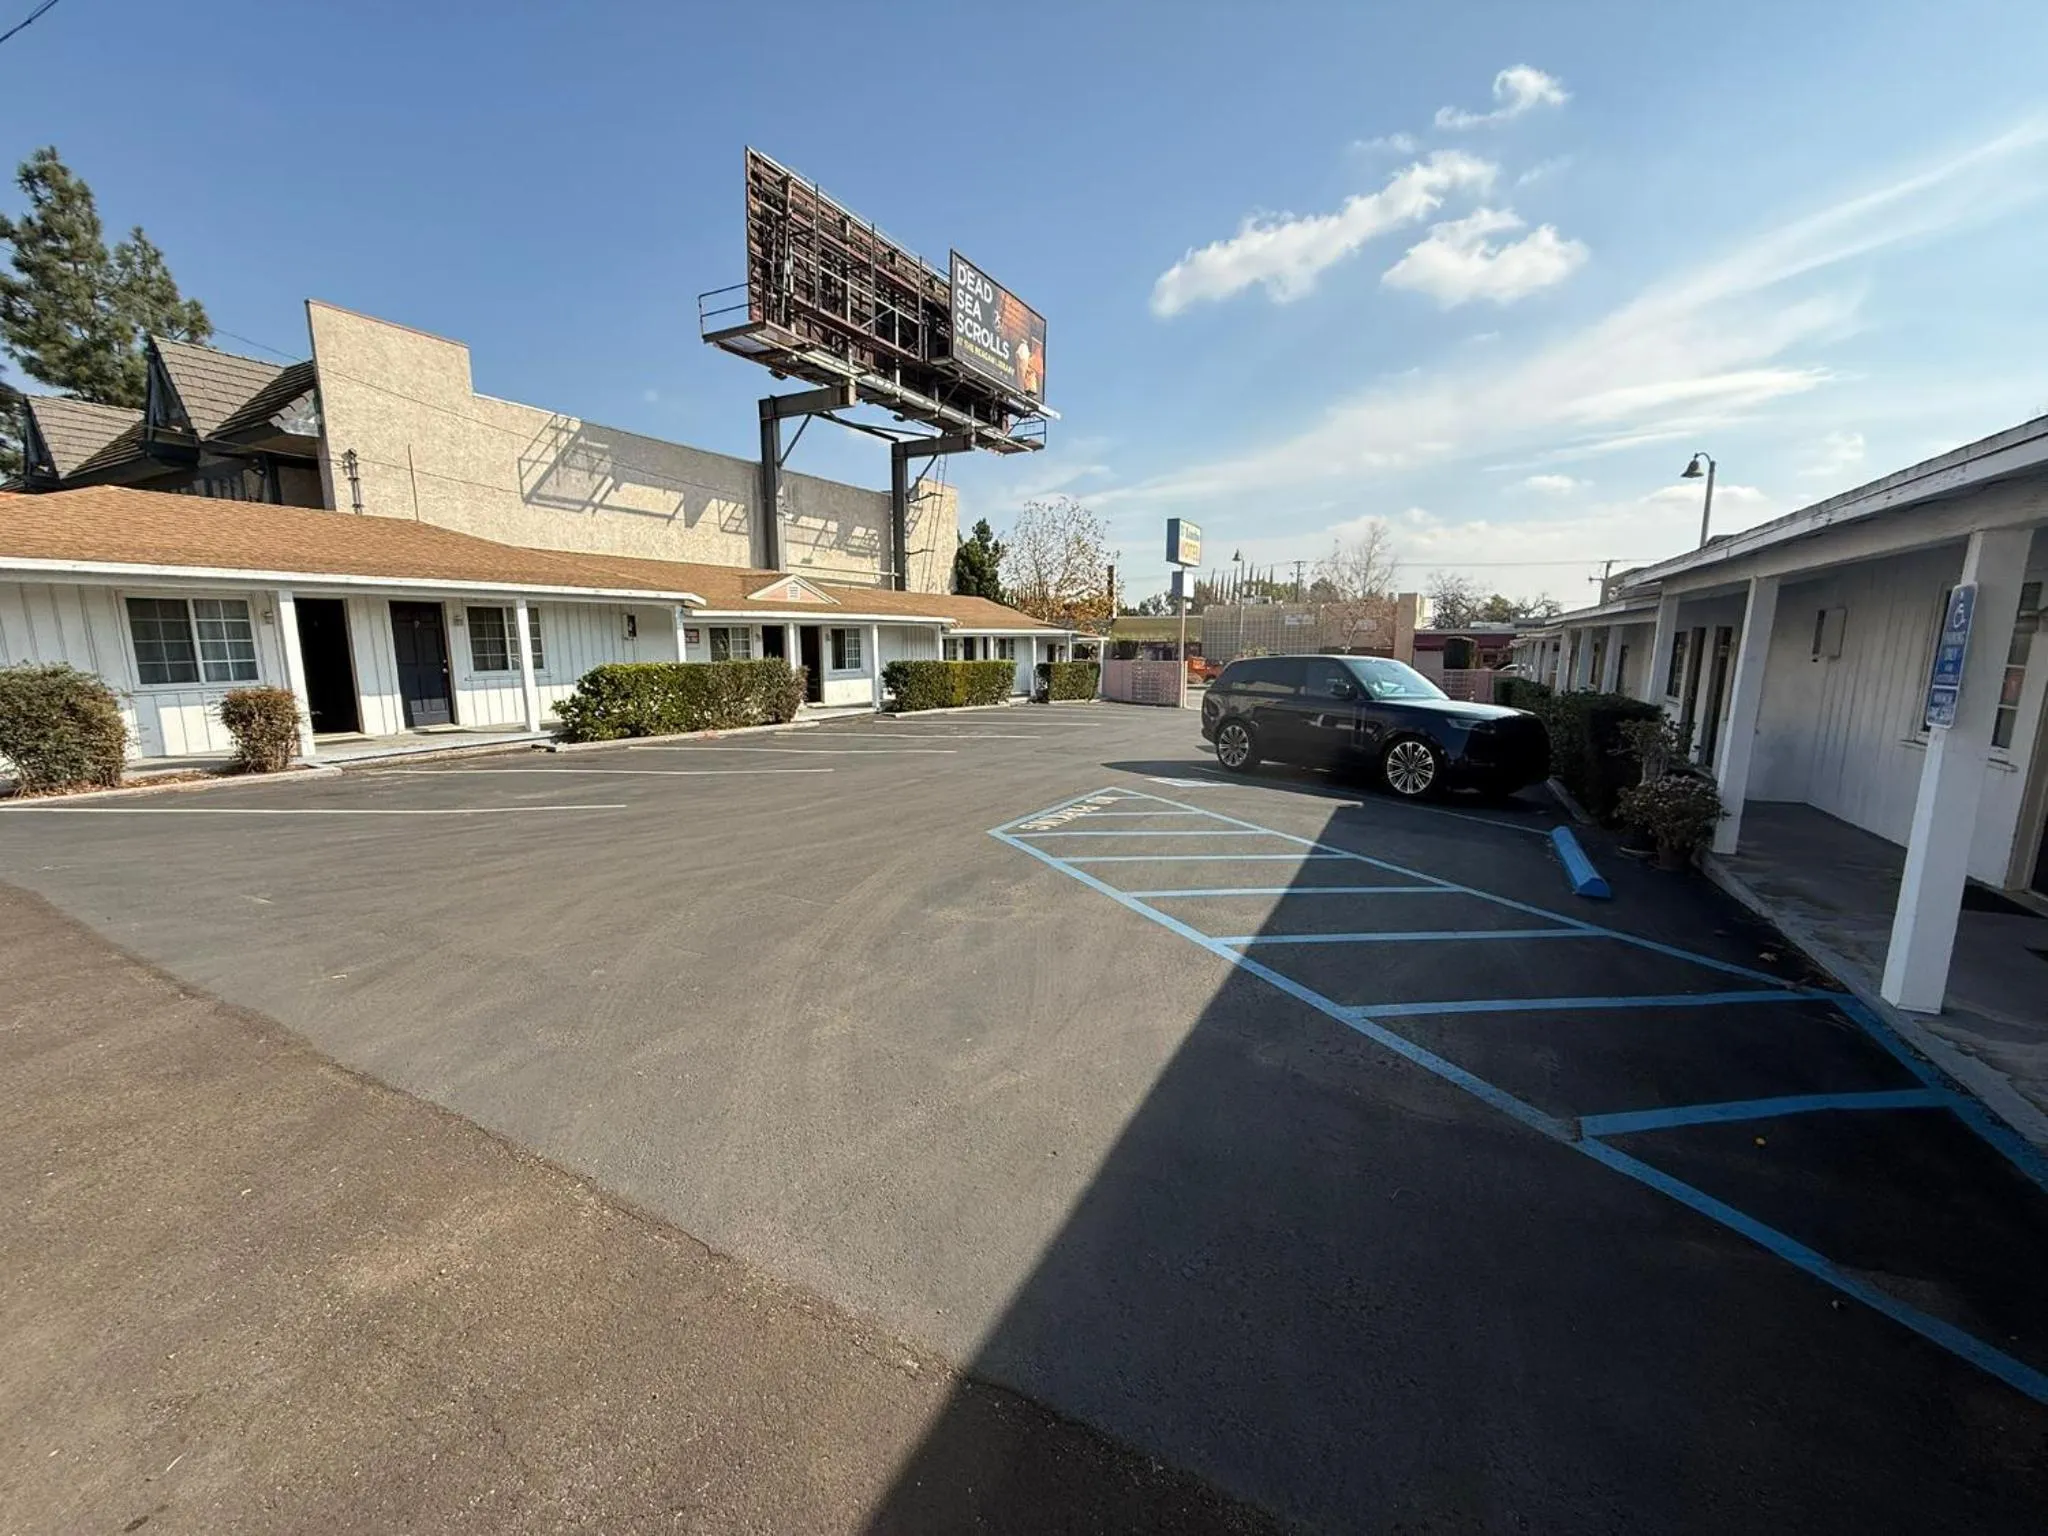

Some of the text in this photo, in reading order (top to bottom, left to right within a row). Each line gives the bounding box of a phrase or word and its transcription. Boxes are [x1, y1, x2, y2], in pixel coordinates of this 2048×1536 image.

[957, 262, 993, 304] DEAD
[956, 289, 982, 322] SEA
[956, 312, 1010, 360] SCROLLS
